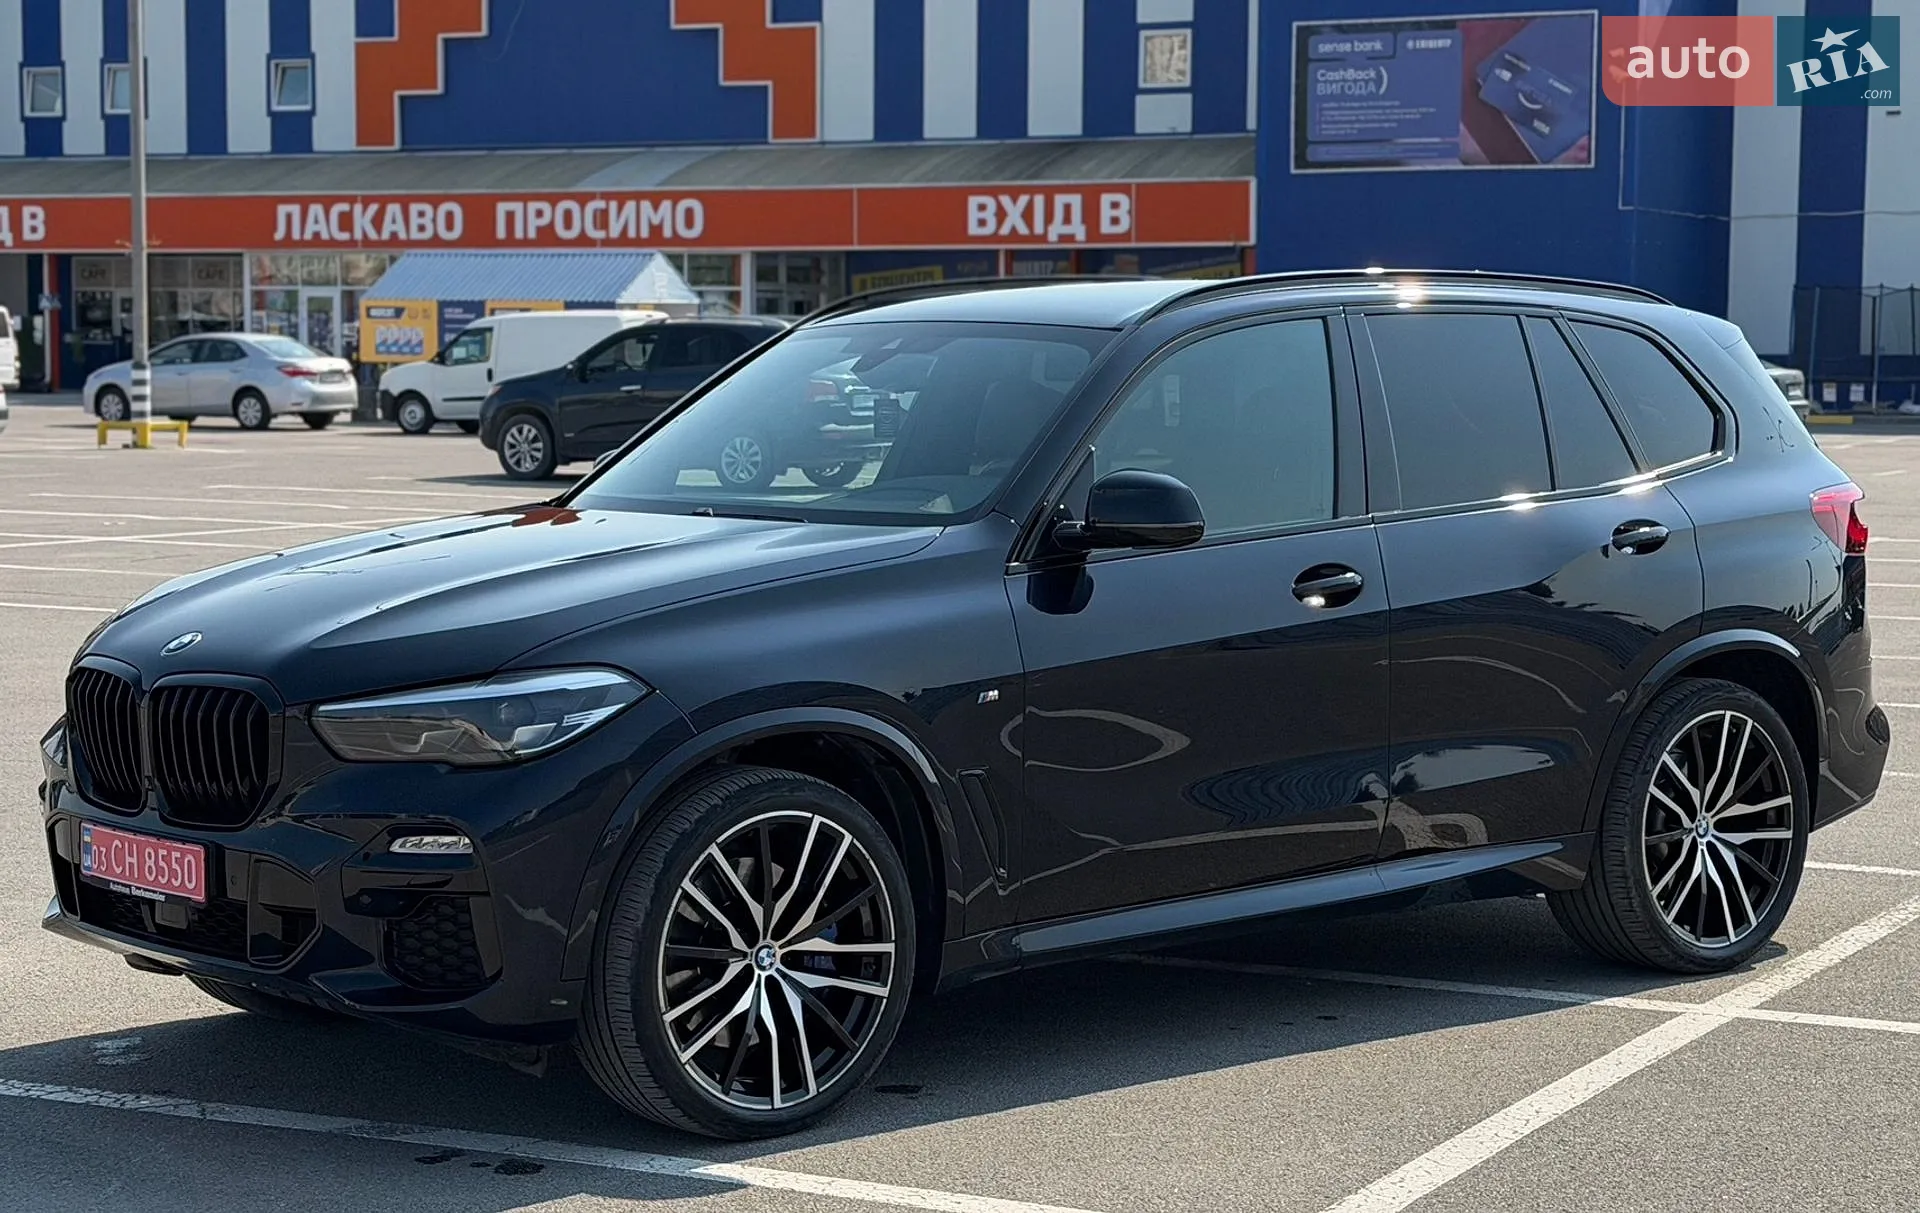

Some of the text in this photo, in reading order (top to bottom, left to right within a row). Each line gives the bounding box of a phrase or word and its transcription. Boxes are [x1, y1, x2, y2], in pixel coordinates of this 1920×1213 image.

[1318, 40, 1383, 53] sense bank
[1316, 68, 1376, 80] CashBack
[1316, 81, 1376, 95] ВИГОДА
[274, 198, 705, 241] ЛАСКАВО ПРОСИМО
[967, 193, 1131, 242] ВХІД В
[92, 839, 197, 890] 03 CH 8550
